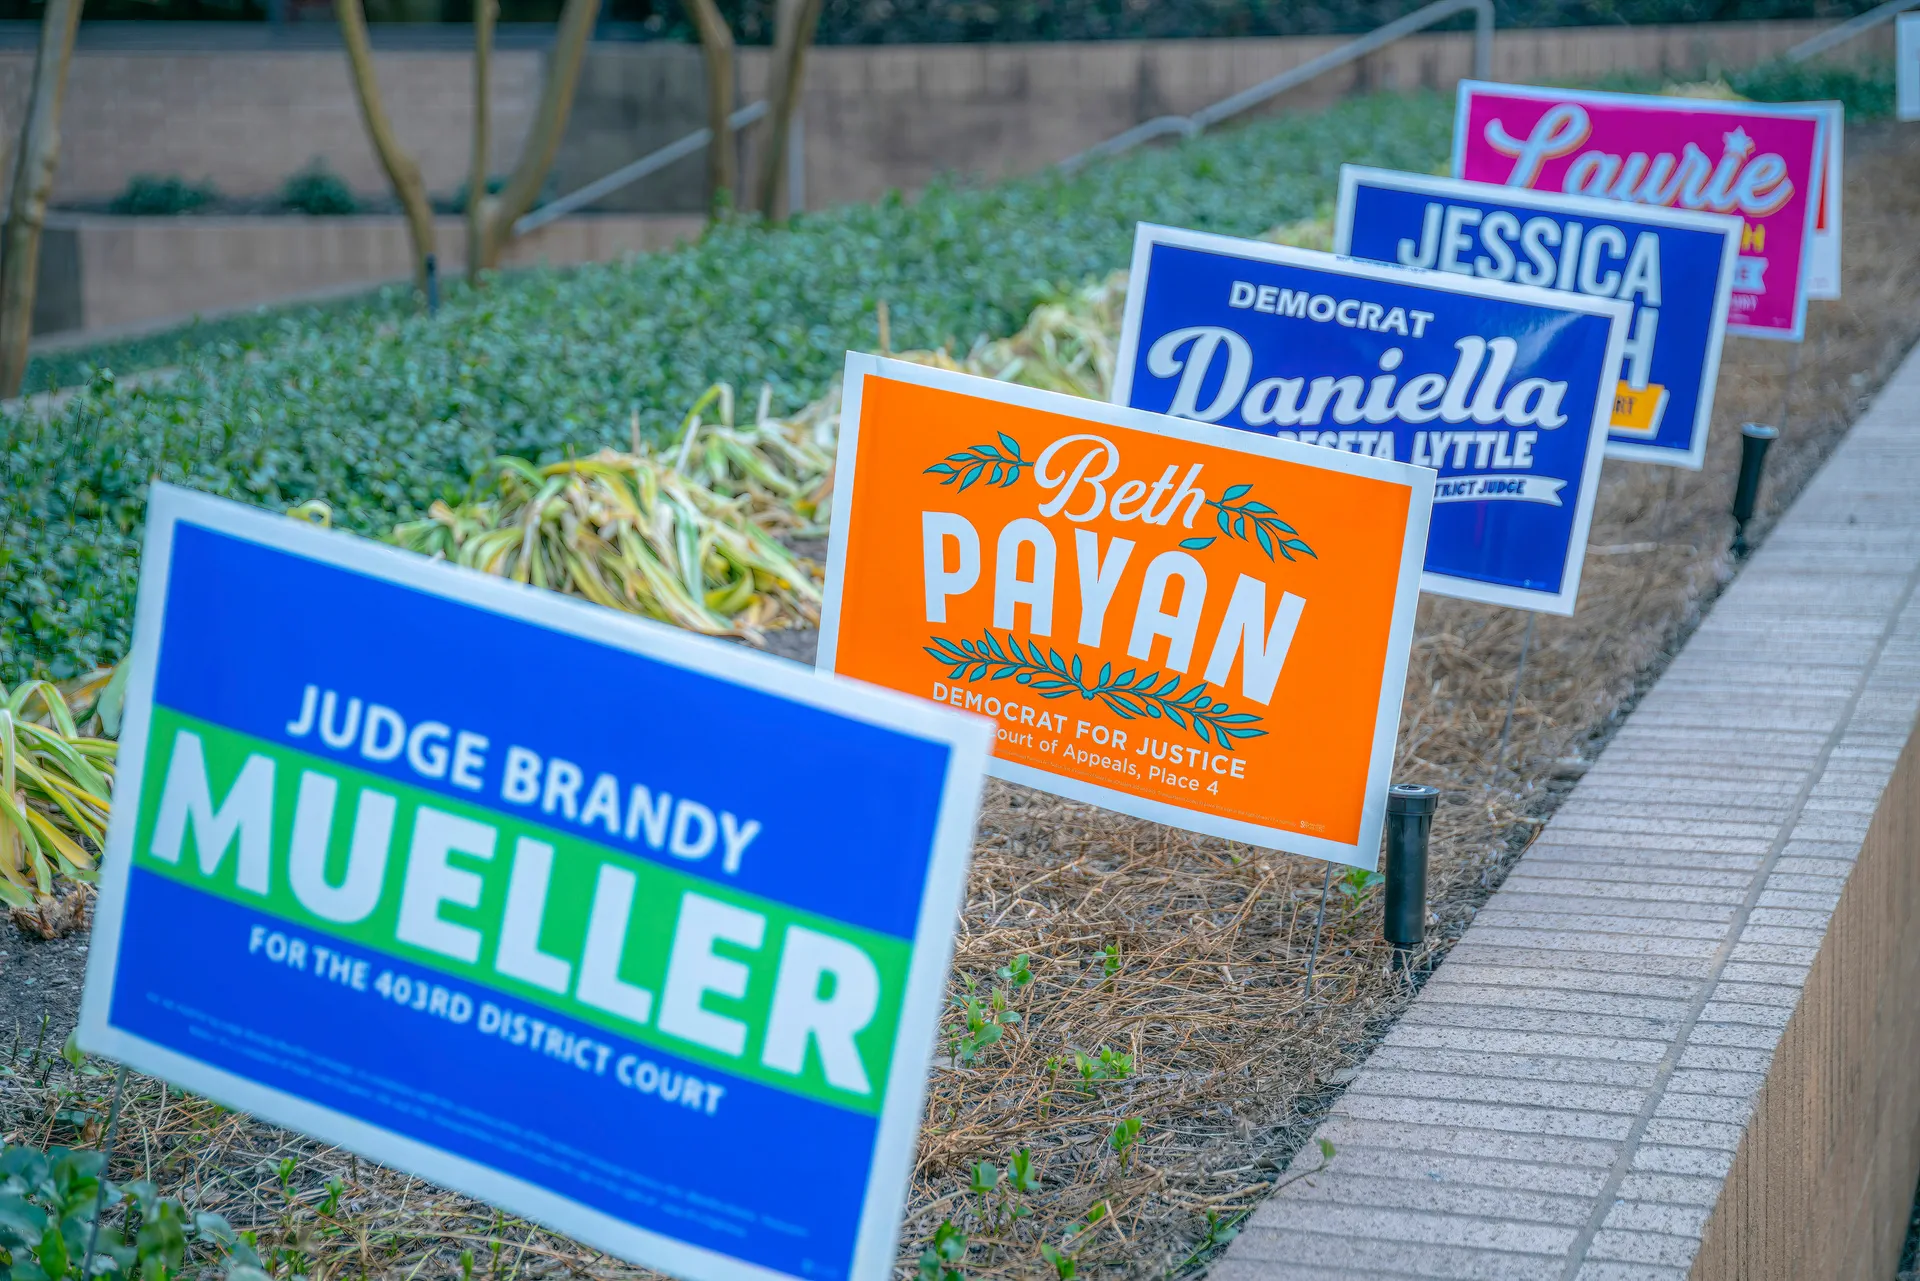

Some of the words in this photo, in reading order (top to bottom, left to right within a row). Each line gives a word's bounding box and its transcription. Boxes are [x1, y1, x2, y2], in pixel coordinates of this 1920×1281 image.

[1484, 103, 1795, 216] Laurie
[1397, 201, 1662, 307] JESSICA
[1228, 280, 1434, 338] DEMOCRAT
[1146, 325, 1568, 430] Daniella
[1033, 433, 1206, 529] Beth
[1411, 431, 1538, 469] LYTTLE
[1478, 479, 1527, 496] JUDGE
[921, 510, 1307, 707] PAYAN
[287, 685, 490, 790] JUDGE
[501, 746, 761, 874] BRANDY
[933, 681, 1068, 734] DEMOCRAT
[1076, 719, 1128, 751] FOR
[1135, 736, 1247, 779] JUSTICE
[992, 726, 1034, 748] ourt
[1039, 739, 1059, 754] of
[1063, 743, 1141, 780] Appeals,
[1148, 765, 1200, 791] Place
[1206, 780, 1219, 796] 4
[149, 728, 882, 1095] MUELLER
[248, 924, 306, 971] FOR
[312, 947, 371, 991] THE
[374, 970, 473, 1024] 403RD
[477, 1001, 614, 1076] DISTRICT
[616, 1054, 726, 1116] COURT
